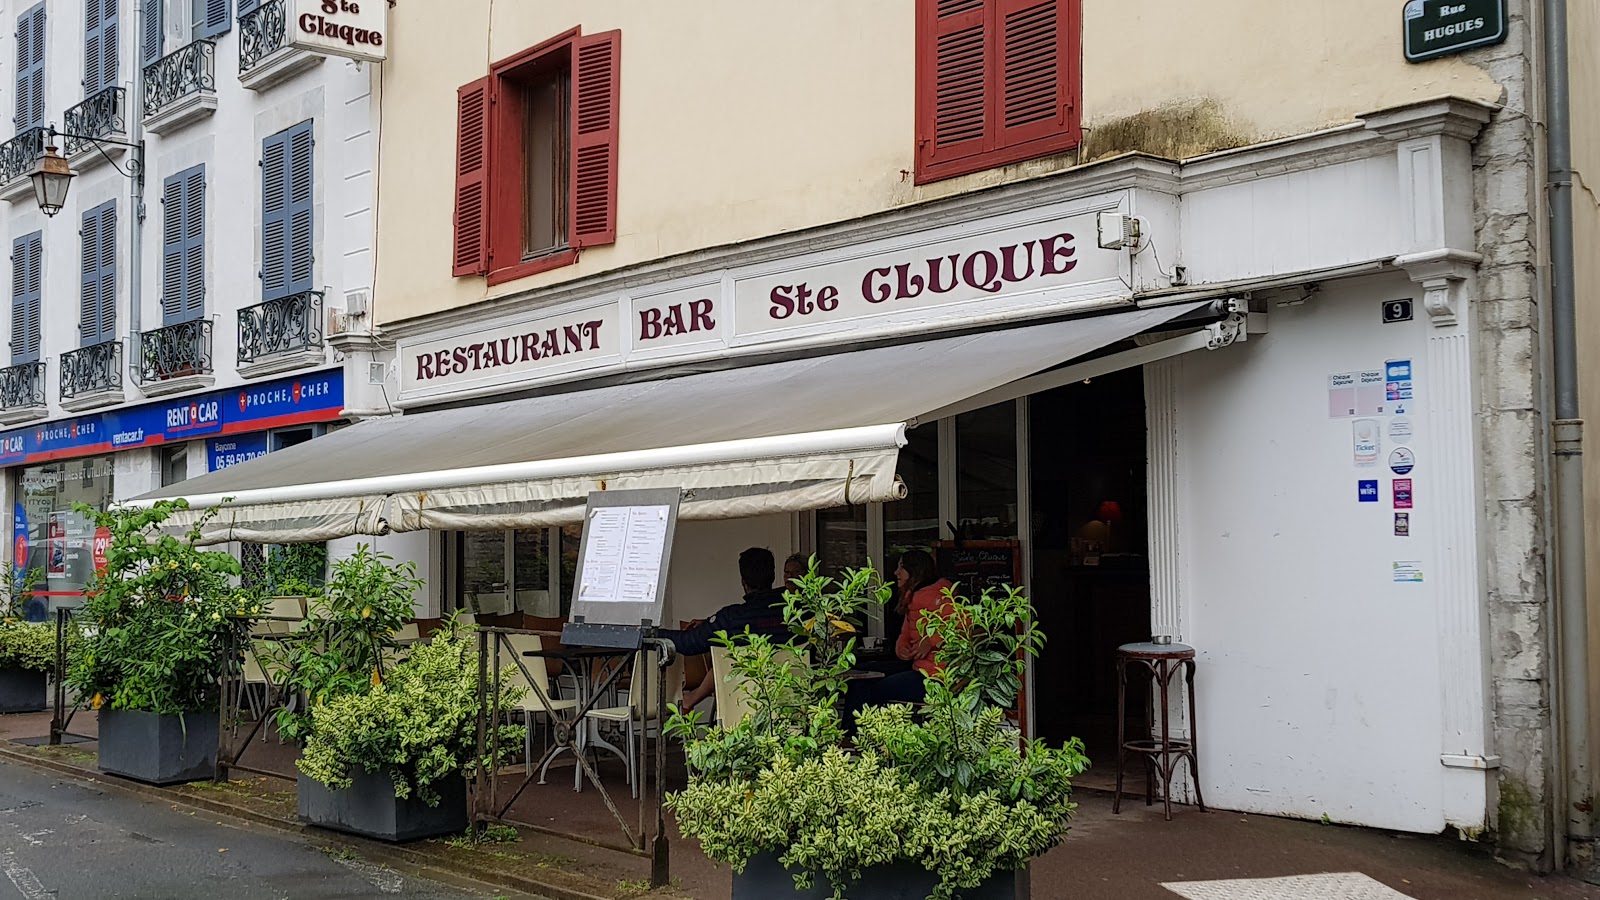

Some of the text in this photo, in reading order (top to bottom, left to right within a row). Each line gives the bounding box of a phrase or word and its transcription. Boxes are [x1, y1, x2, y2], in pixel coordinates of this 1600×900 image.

[1440, 4, 1466, 17] Rue
[299, 13, 383, 46] Cluque
[1424, 17, 1484, 41] HUGUES
[769, 233, 1078, 320] Ste CLUQUE
[639, 299, 716, 341] BAR
[1392, 303, 1403, 318] 9
[416, 319, 603, 381] RESTAURANT
[167, 402, 218, 427] RENT a CAR
[10, 436, 23, 451] CAR
[113, 428, 144, 445] rentacar.fr
[215, 443, 236, 453] Bayonne
[216, 456, 225, 470] 05
